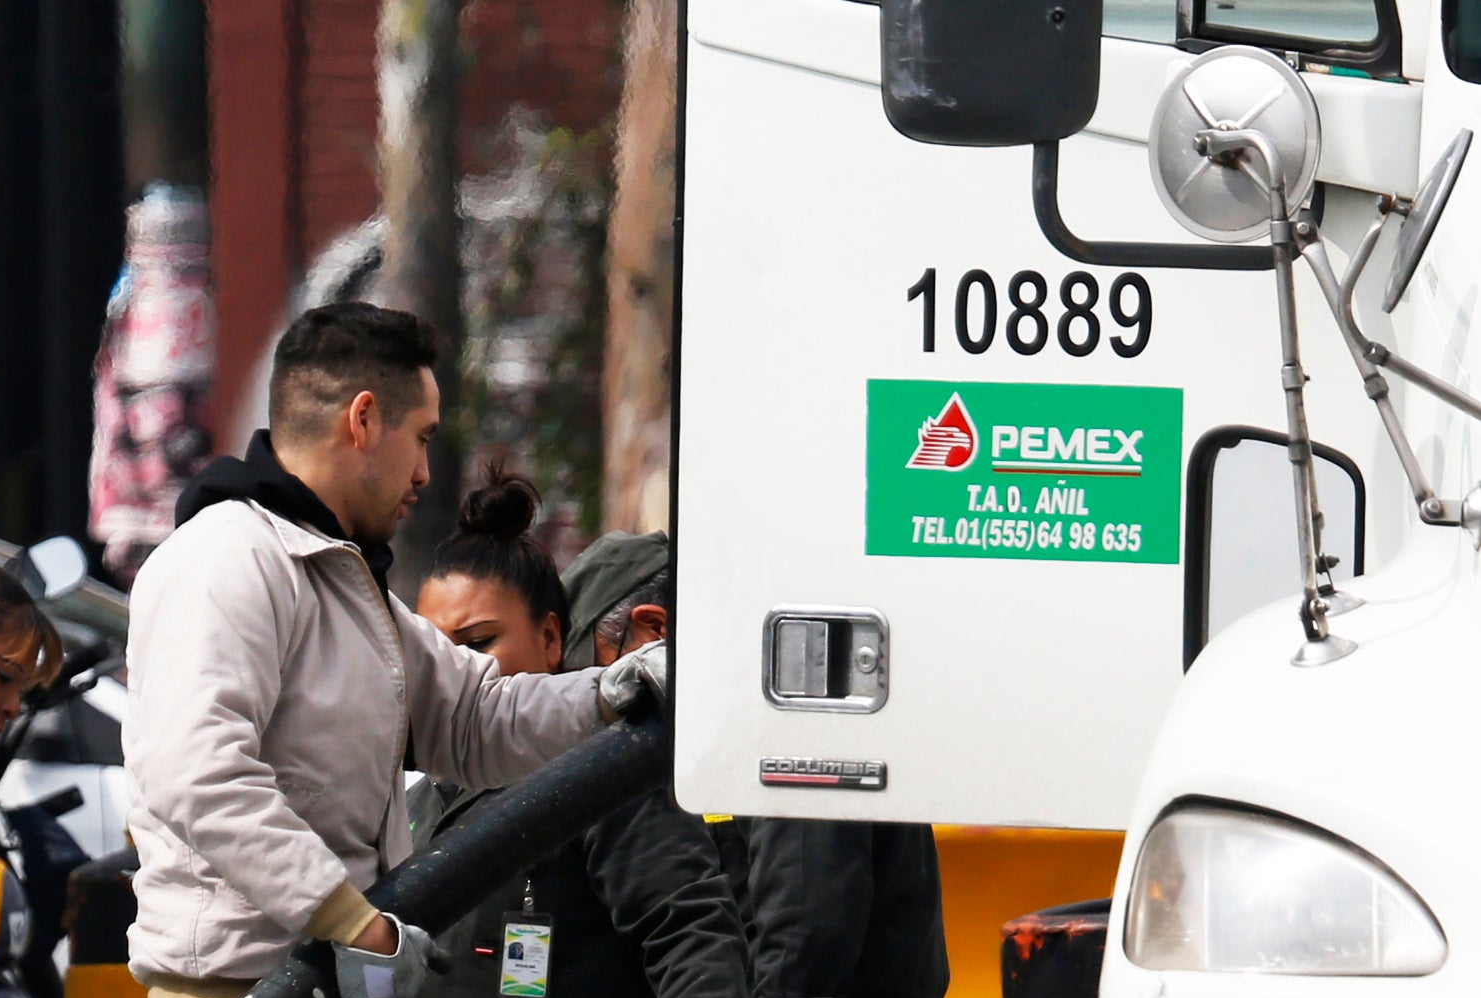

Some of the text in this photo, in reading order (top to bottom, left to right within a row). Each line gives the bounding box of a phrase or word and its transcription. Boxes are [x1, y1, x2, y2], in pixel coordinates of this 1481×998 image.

[907, 268, 1153, 359] 10889
[991, 425, 1144, 462] PEMEX
[1034, 479, 1089, 515] AÑIL
[1068, 521, 1096, 551] 98
[1101, 523, 1142, 552] 635
